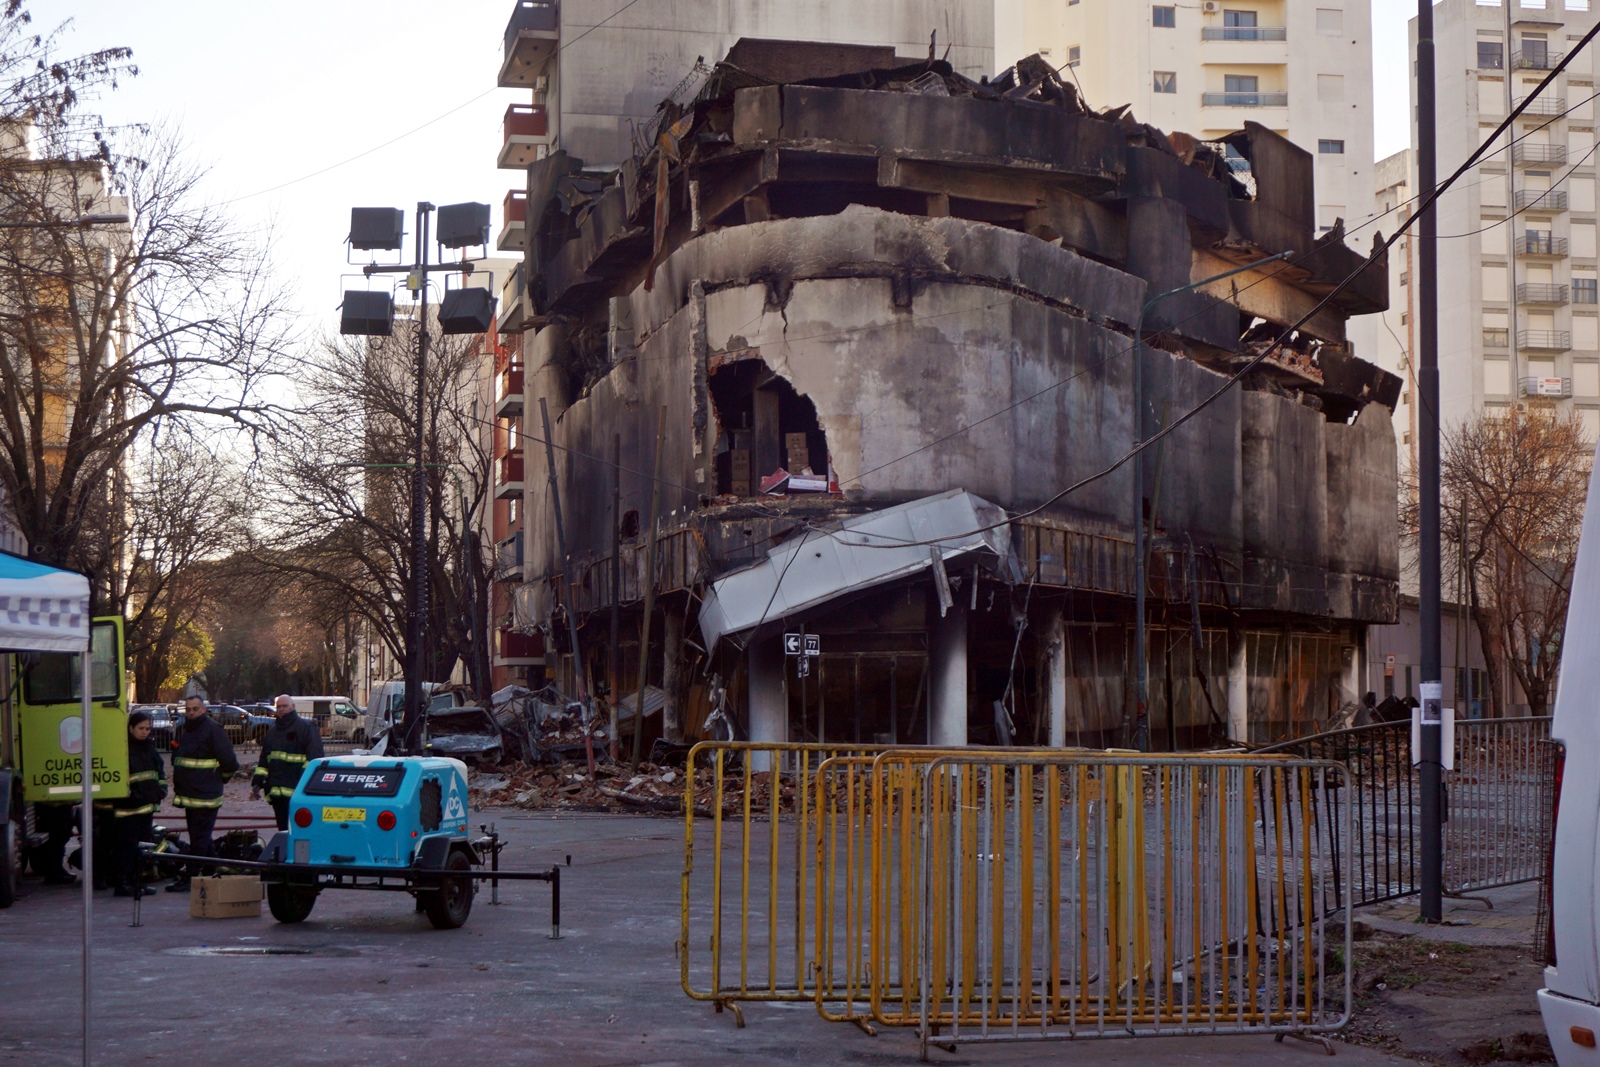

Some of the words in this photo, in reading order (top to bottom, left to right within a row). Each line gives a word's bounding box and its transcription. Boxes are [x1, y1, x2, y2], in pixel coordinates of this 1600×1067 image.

[808, 640, 816, 648] 77
[45, 757, 108, 771] CUAREL
[33, 773, 60, 786] LOS
[63, 770, 121, 784] HONOS
[339, 774, 386, 783] TEREX
[449, 796, 460, 810] DC
